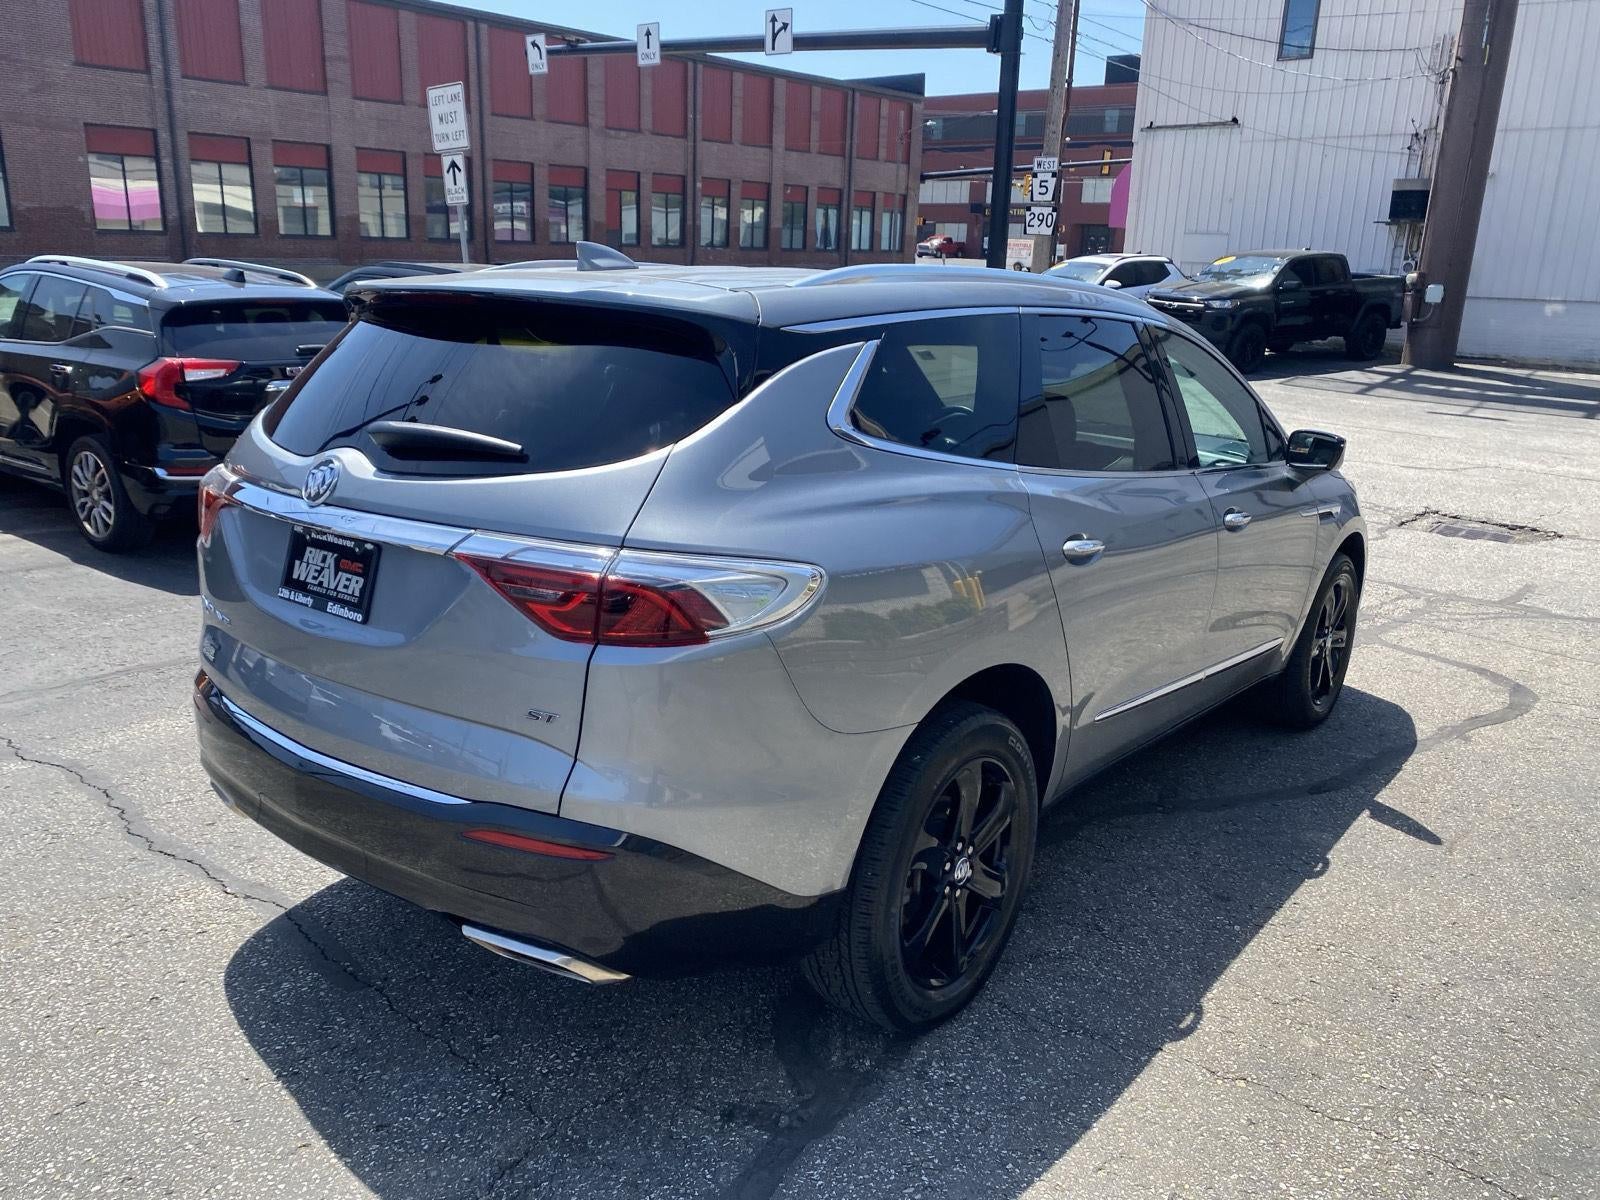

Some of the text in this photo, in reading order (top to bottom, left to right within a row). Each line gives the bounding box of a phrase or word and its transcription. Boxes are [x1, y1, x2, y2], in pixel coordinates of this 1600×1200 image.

[641, 51, 656, 60] ONLY
[531, 63, 544, 71] ONLY
[431, 91, 462, 106] LEFT LANE
[439, 111, 457, 125] MUST
[435, 129, 465, 143] TURN LEFT
[1036, 160, 1056, 170] WEST
[447, 186, 465, 196] BLACK
[1038, 180, 1049, 196] 5
[1027, 212, 1054, 228] 290
[303, 546, 338, 568] RICK
[340, 559, 364, 573] GMC
[292, 559, 364, 597] WEAVER
[278, 587, 290, 599] 12th
[295, 592, 314, 607] Liberty
[327, 589, 337, 597] FOR
[337, 592, 359, 603] SERVICE
[326, 601, 363, 622] Edinboro
[526, 709, 560, 724] ST
